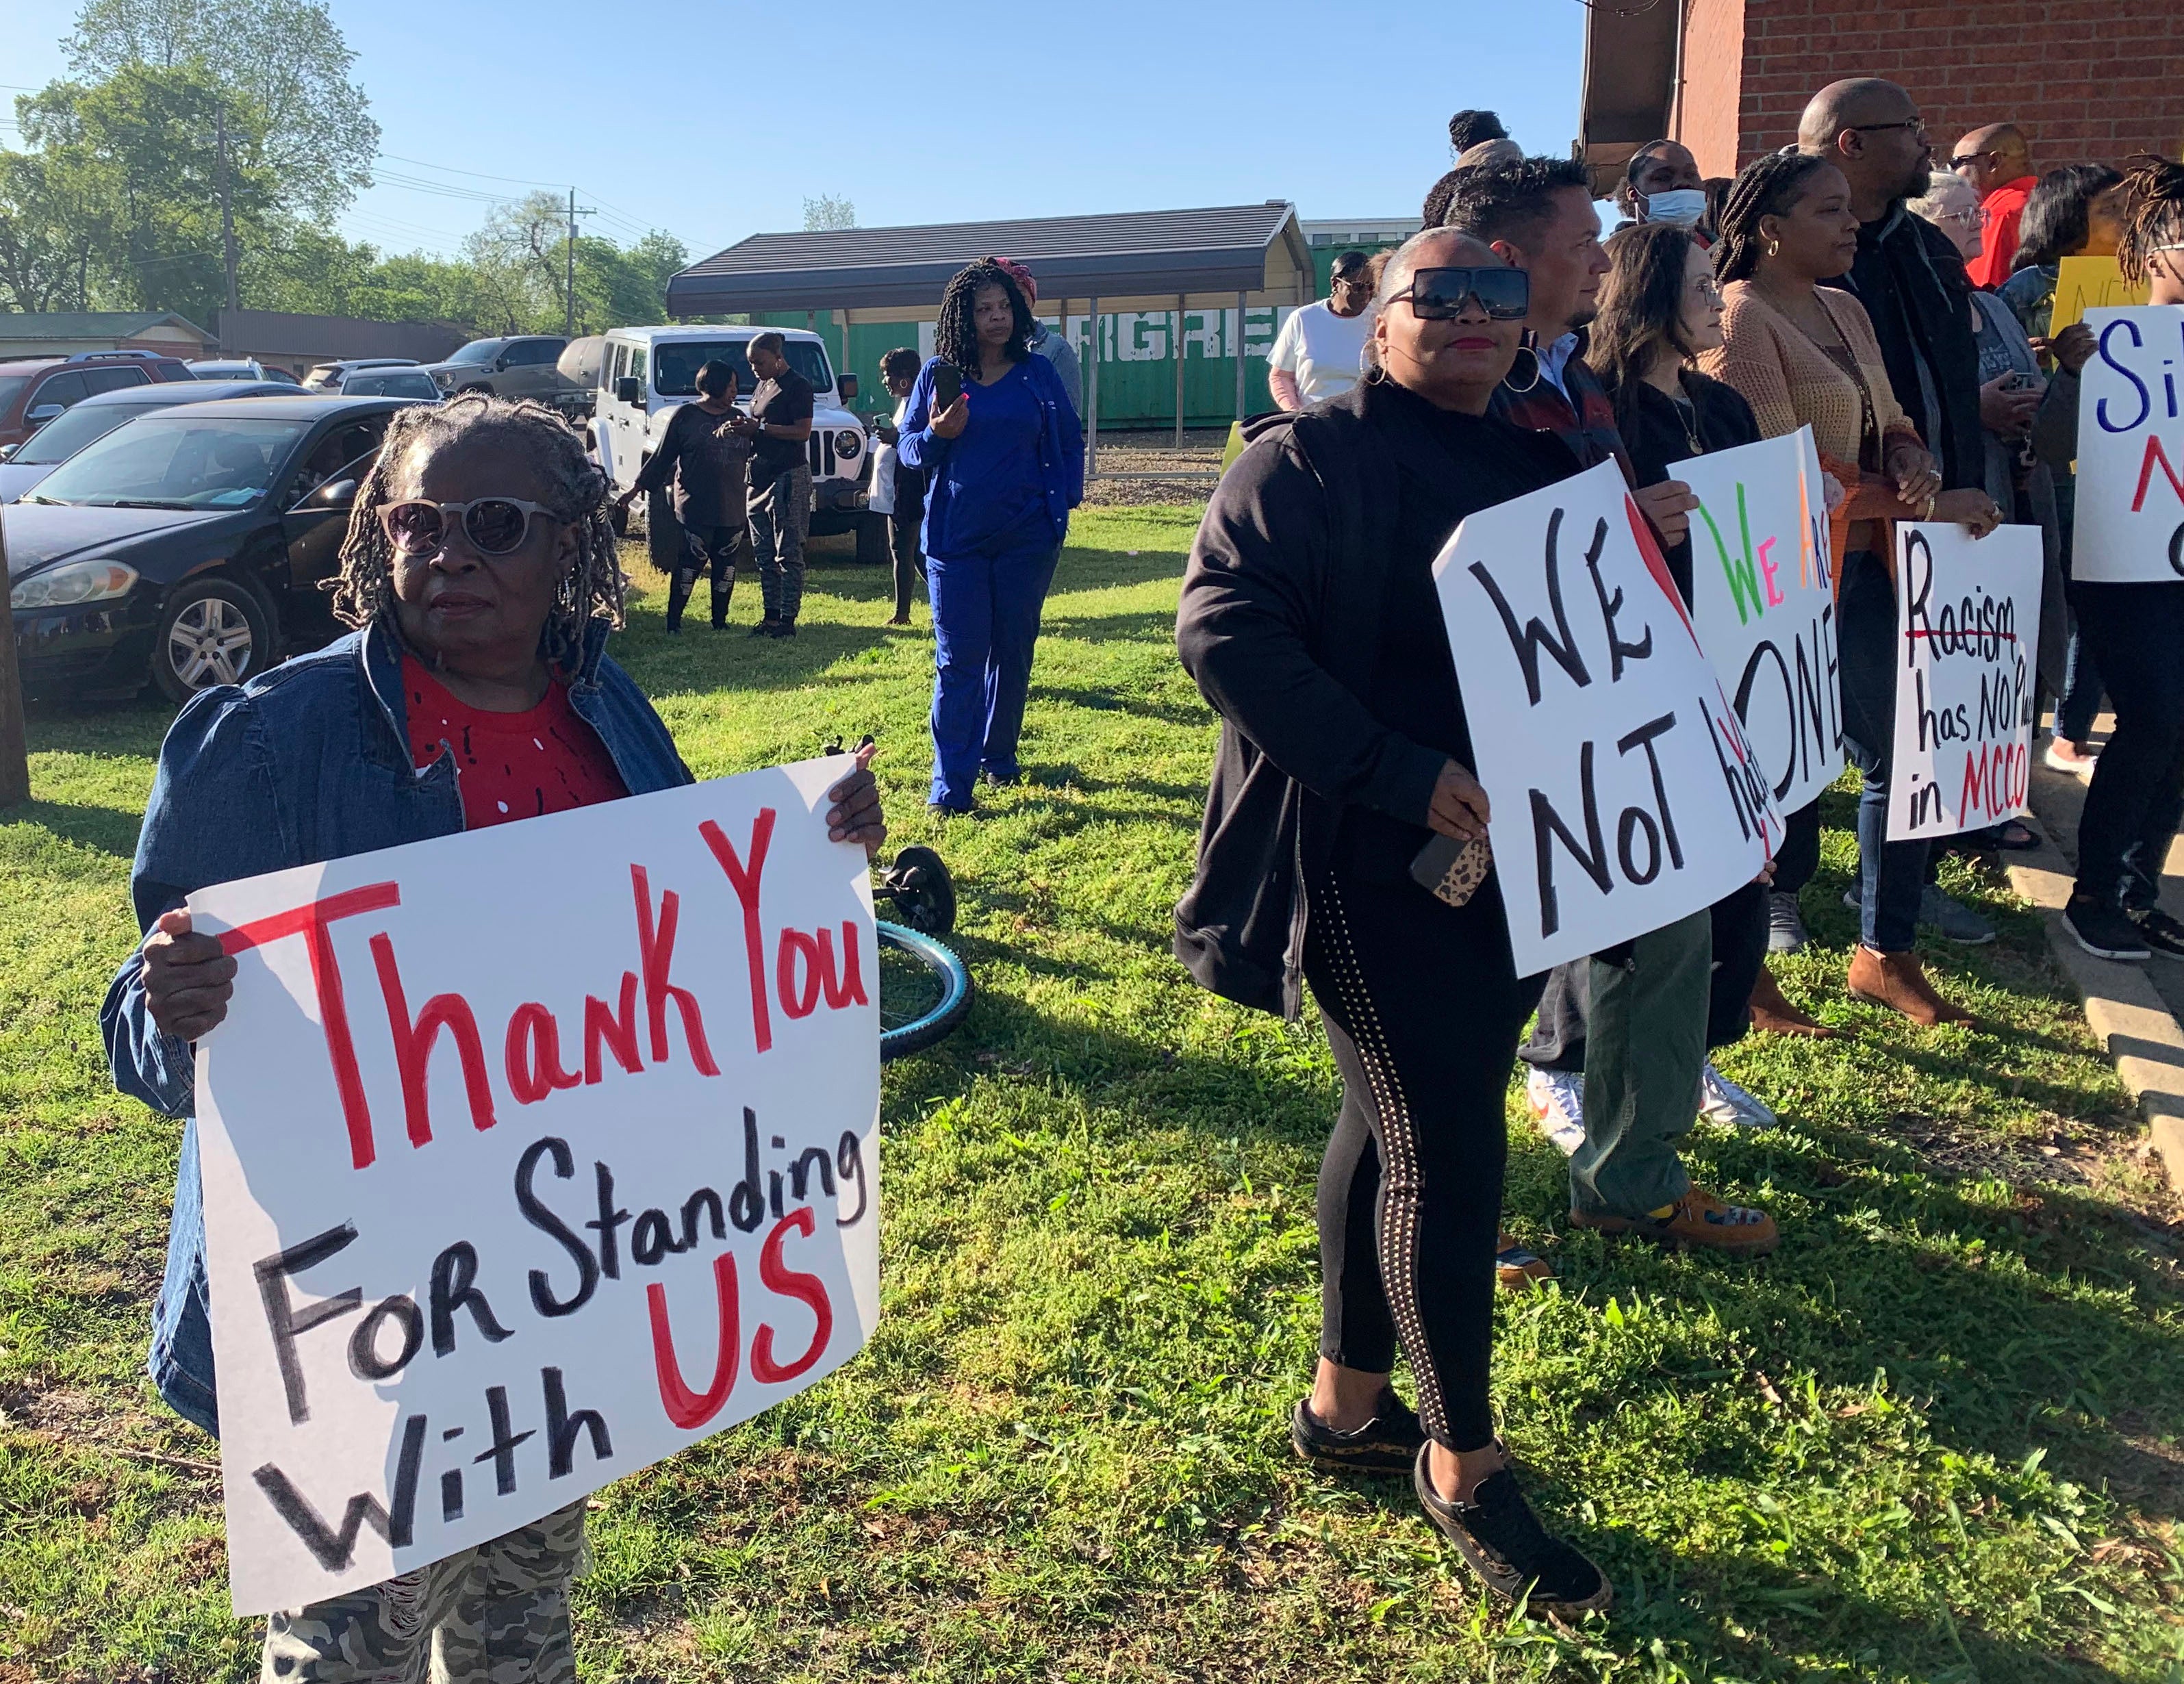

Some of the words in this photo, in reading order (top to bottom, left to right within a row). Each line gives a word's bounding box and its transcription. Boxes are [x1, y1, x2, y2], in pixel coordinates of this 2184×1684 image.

[2096, 318, 2184, 433] Si
[1467, 507, 1653, 707] WE
[1699, 481, 1785, 626] WE
[1904, 529, 2017, 668] Racism
[1734, 602, 1844, 803] ONE
[1916, 668, 1970, 752] has
[1977, 667, 2011, 743] NO
[1909, 774, 1943, 830] in
[698, 807, 869, 1054] You
[513, 1105, 867, 1318] Standing
[251, 1366, 614, 1576] With
[646, 1205, 833, 1430] US
